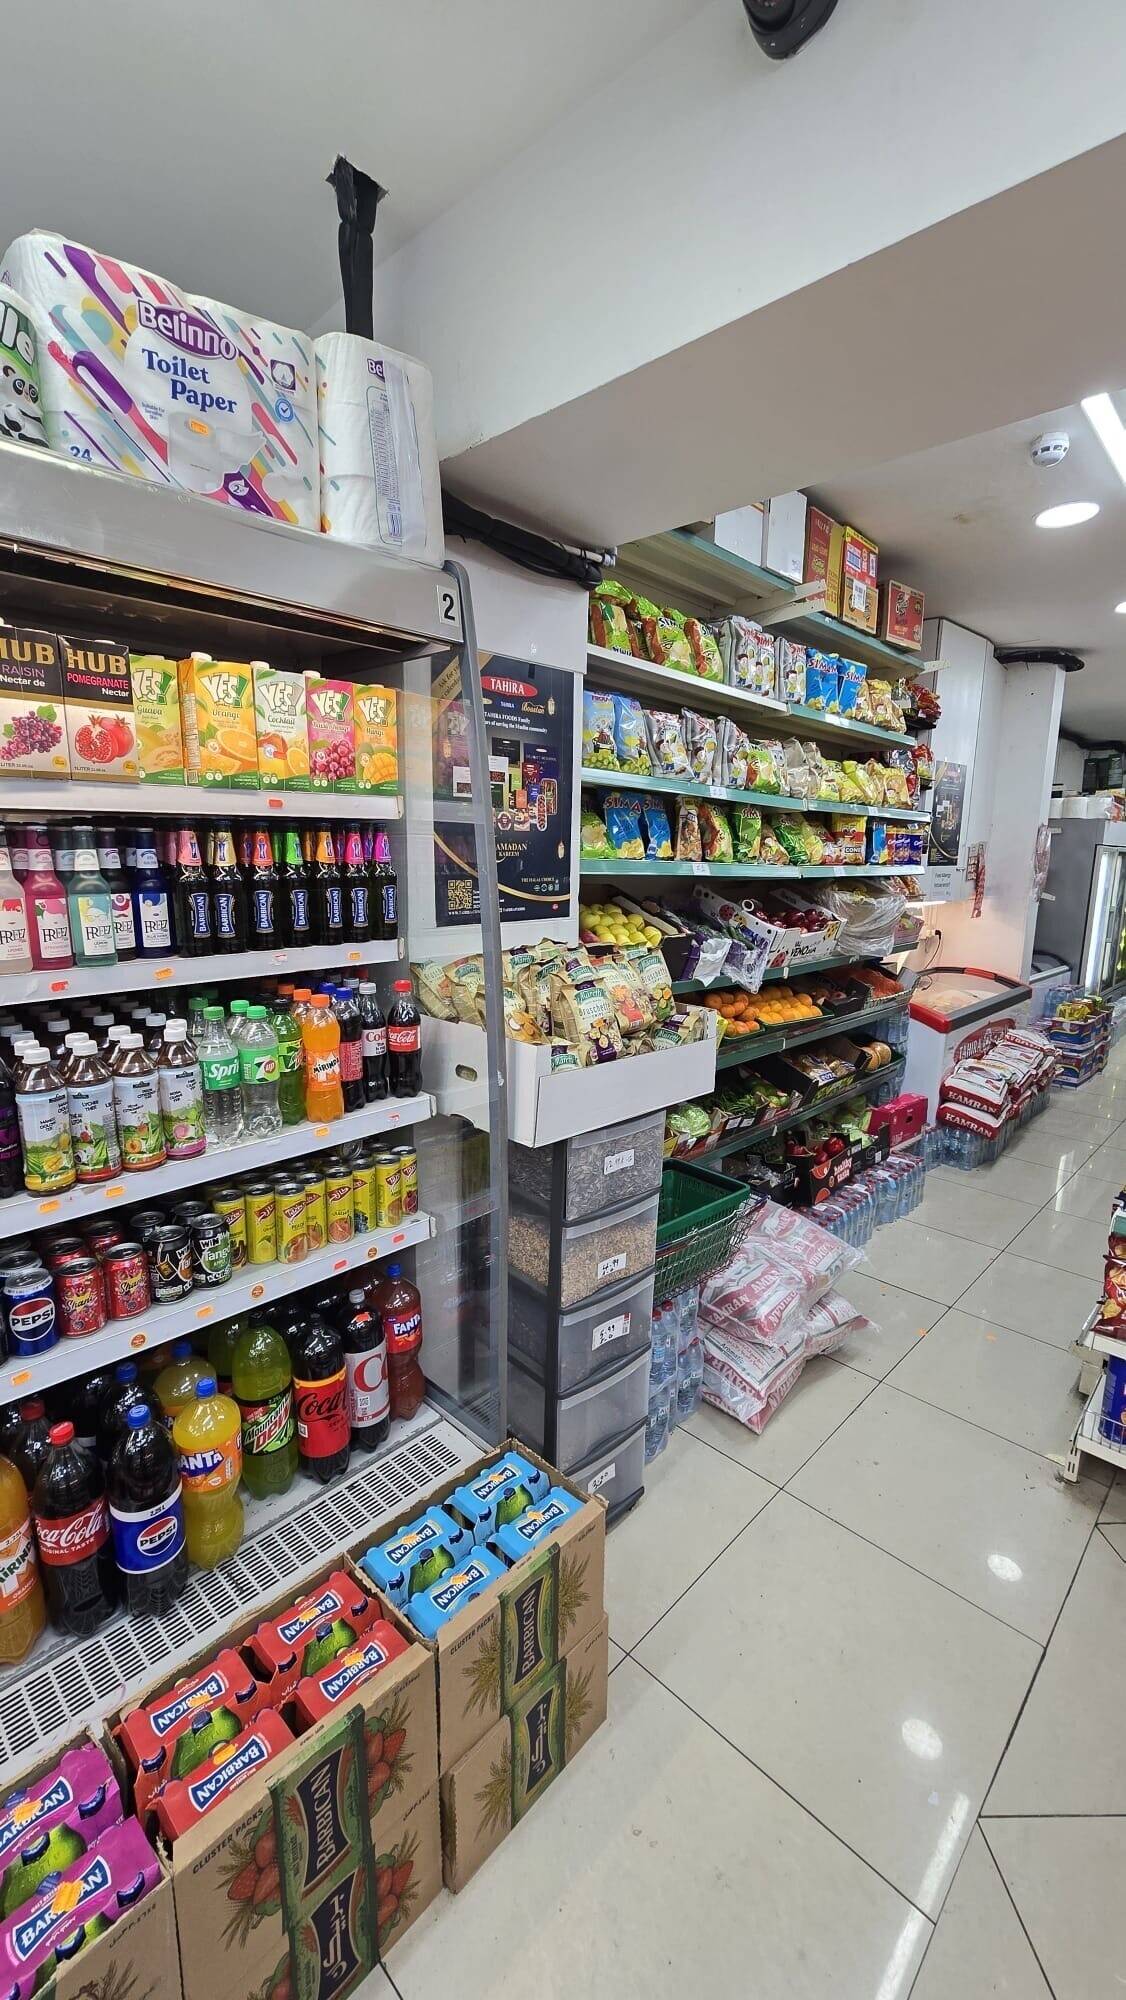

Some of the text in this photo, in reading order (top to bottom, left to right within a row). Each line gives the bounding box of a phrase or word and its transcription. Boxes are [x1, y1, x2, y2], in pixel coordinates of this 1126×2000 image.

[138, 300, 236, 359] Belinno
[142, 349, 210, 384] Toilet
[171, 379, 238, 413] Paper
[442, 593, 456, 621] 2
[3, 664, 45, 678] RAISIN
[66, 647, 127, 675] HUB
[0, 674, 45, 687] Nectar de
[67, 672, 129, 690] POMEGRANATE
[102, 687, 129, 697] Nectar
[132, 668, 174, 706] YES!
[199, 672, 248, 708] YES!
[490, 678, 525, 695] TAHIRA
[137, 705, 162, 715] Guava
[258, 681, 304, 716] YES!
[310, 690, 351, 722] YES!
[357, 696, 394, 727] YES!
[496, 842, 527, 851] AMADAN
[198, 896, 207, 932] BARBICAN
[948, 1090, 996, 1114] KAMRAN
[945, 1112, 992, 1138] KAMRAN
[12, 1308, 54, 1327] PEPSI
[140, 1523, 176, 1547] PEPSI
[449, 1631, 476, 1656] CLUSTER
[522, 1588, 536, 1675] BARBICAN
[196, 1741, 260, 1804] BARBICAN
[312, 1763, 336, 1871] BARBICAN
[193, 1806, 264, 1875] CLUSTER PACKS
